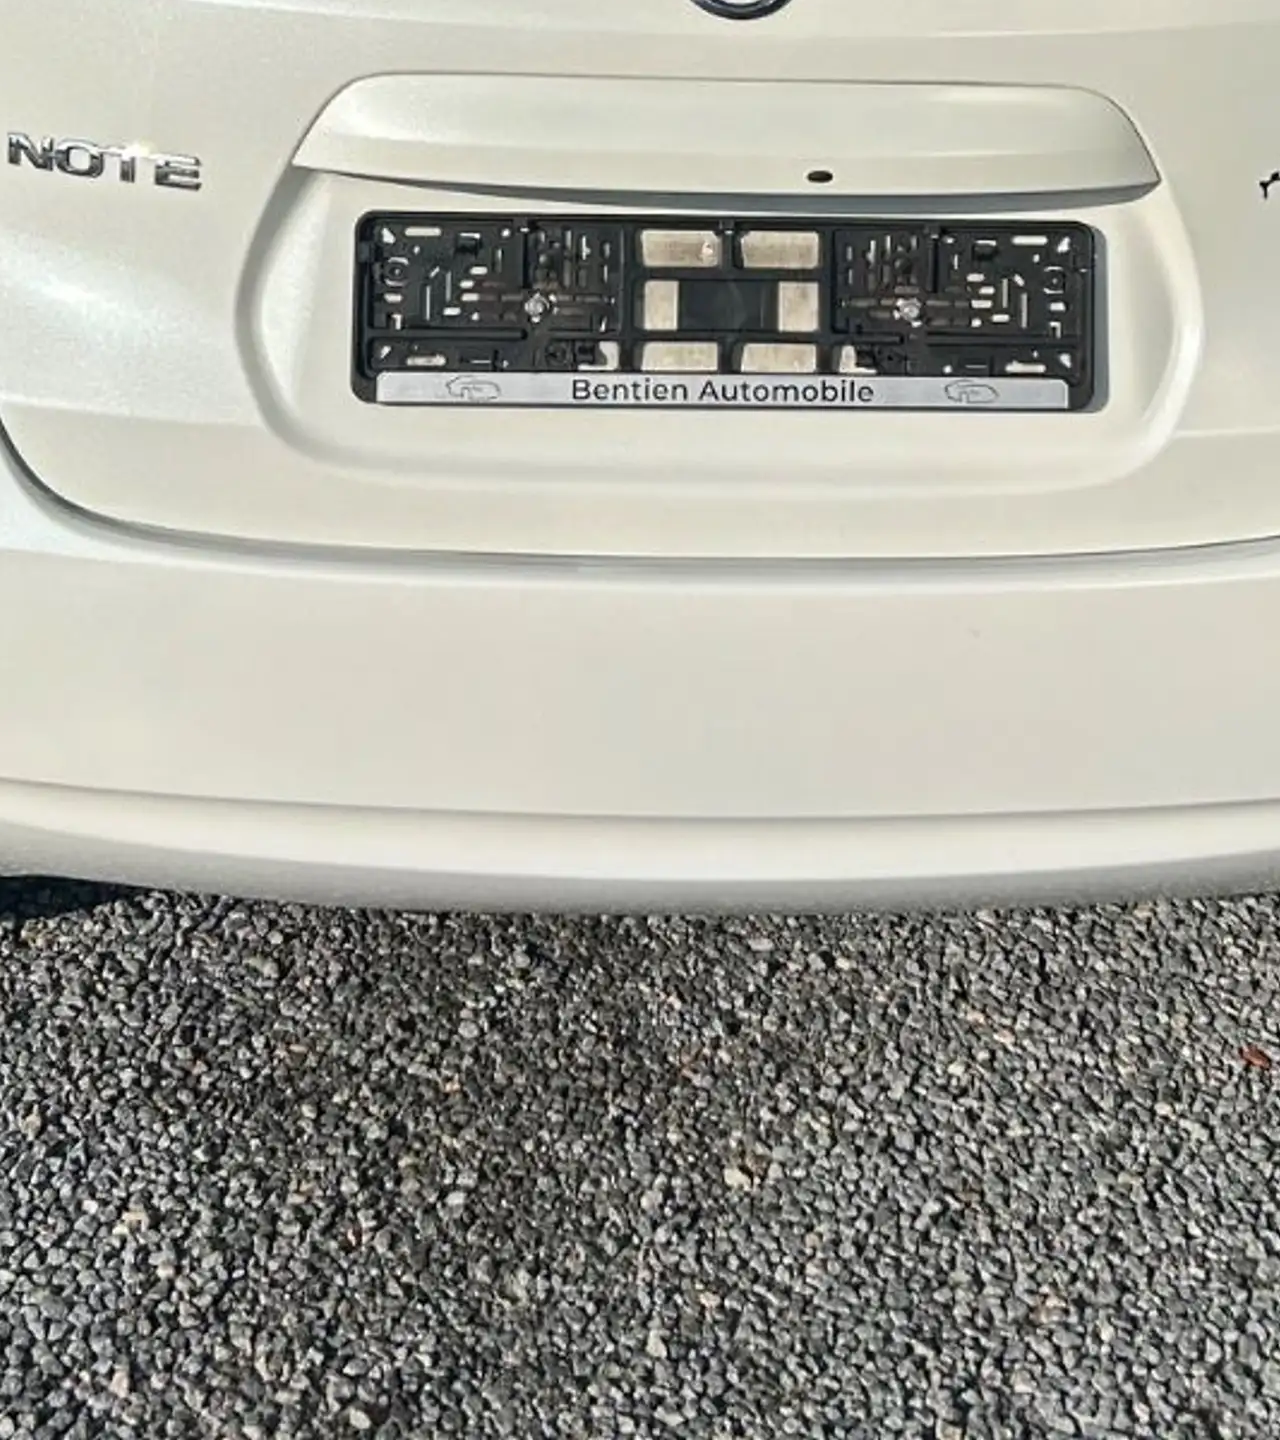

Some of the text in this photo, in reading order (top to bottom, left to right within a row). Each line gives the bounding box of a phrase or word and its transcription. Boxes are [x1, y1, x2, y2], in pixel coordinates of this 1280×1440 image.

[7, 130, 202, 191] NOTE
[571, 377, 875, 403] Bentien Automobile
